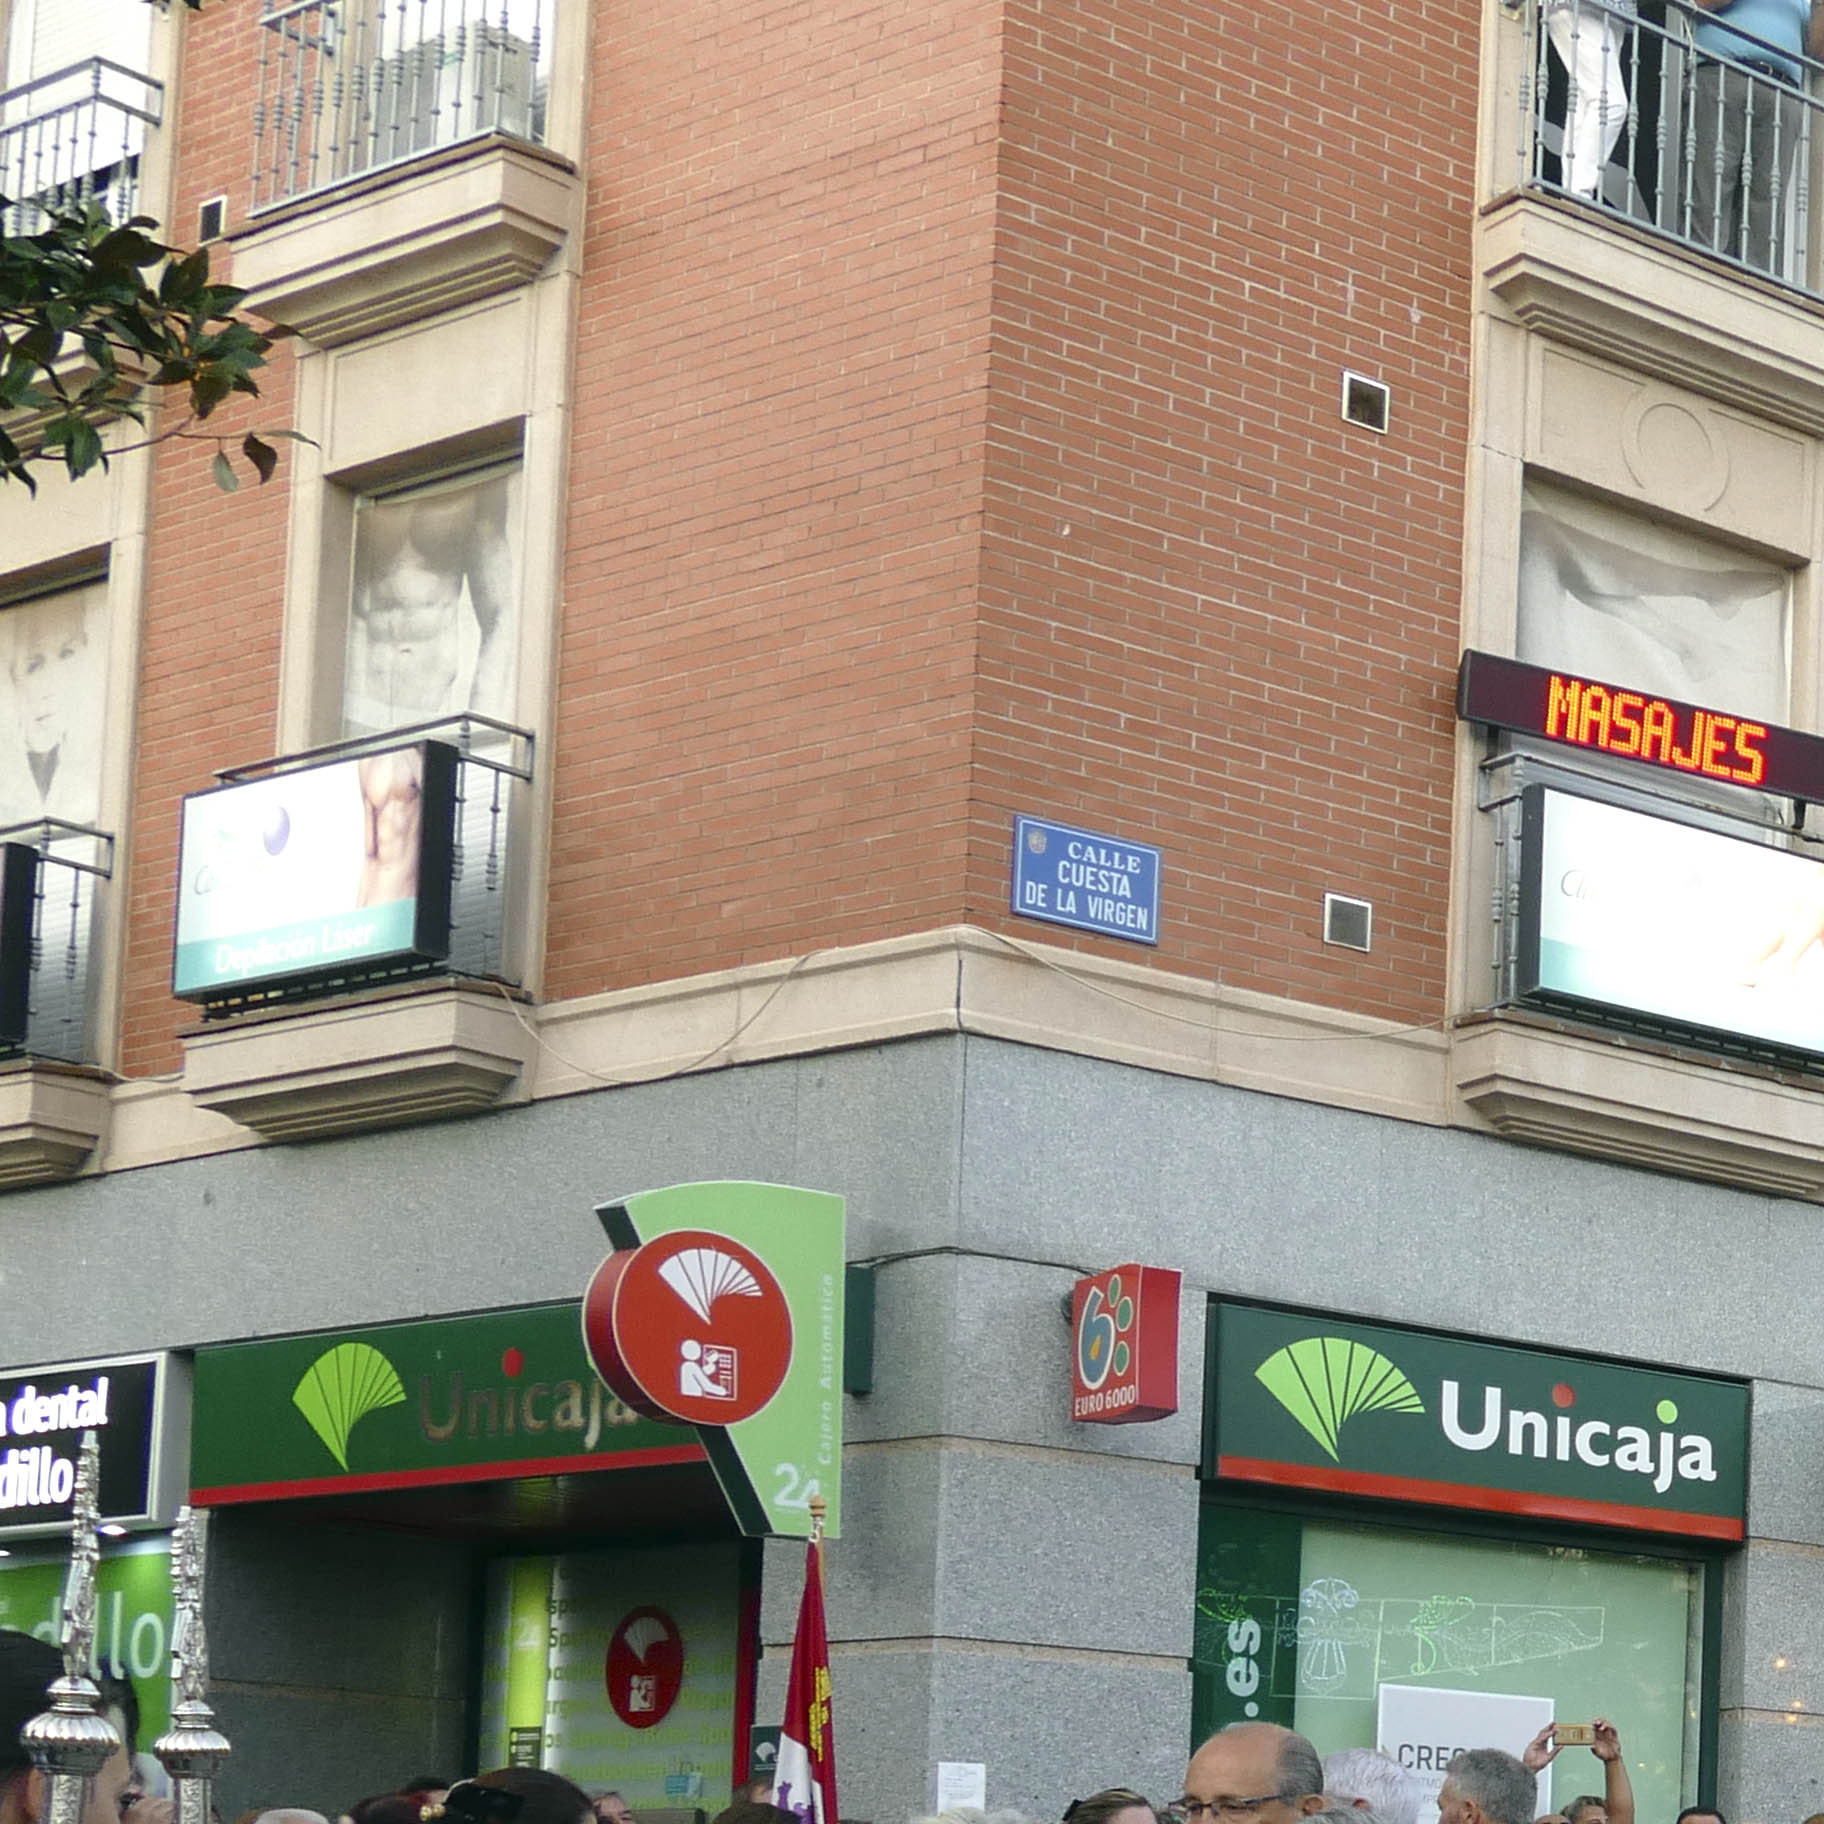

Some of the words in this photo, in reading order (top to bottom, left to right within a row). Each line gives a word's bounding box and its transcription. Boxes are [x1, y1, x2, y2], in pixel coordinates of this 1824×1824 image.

[1545, 674, 1767, 785] MASAJES
[1057, 860, 1132, 898] CUESTA
[1067, 841, 1142, 874] CALLE
[1025, 880, 1048, 908] DE
[1056, 888, 1077, 914] LA
[1087, 894, 1148, 931] VIRGEN
[11, 1375, 109, 1436] dental
[1074, 1392, 1104, 1417] EURO
[1104, 1384, 1136, 1410] 6000
[1441, 1379, 1718, 1495] Unicaja
